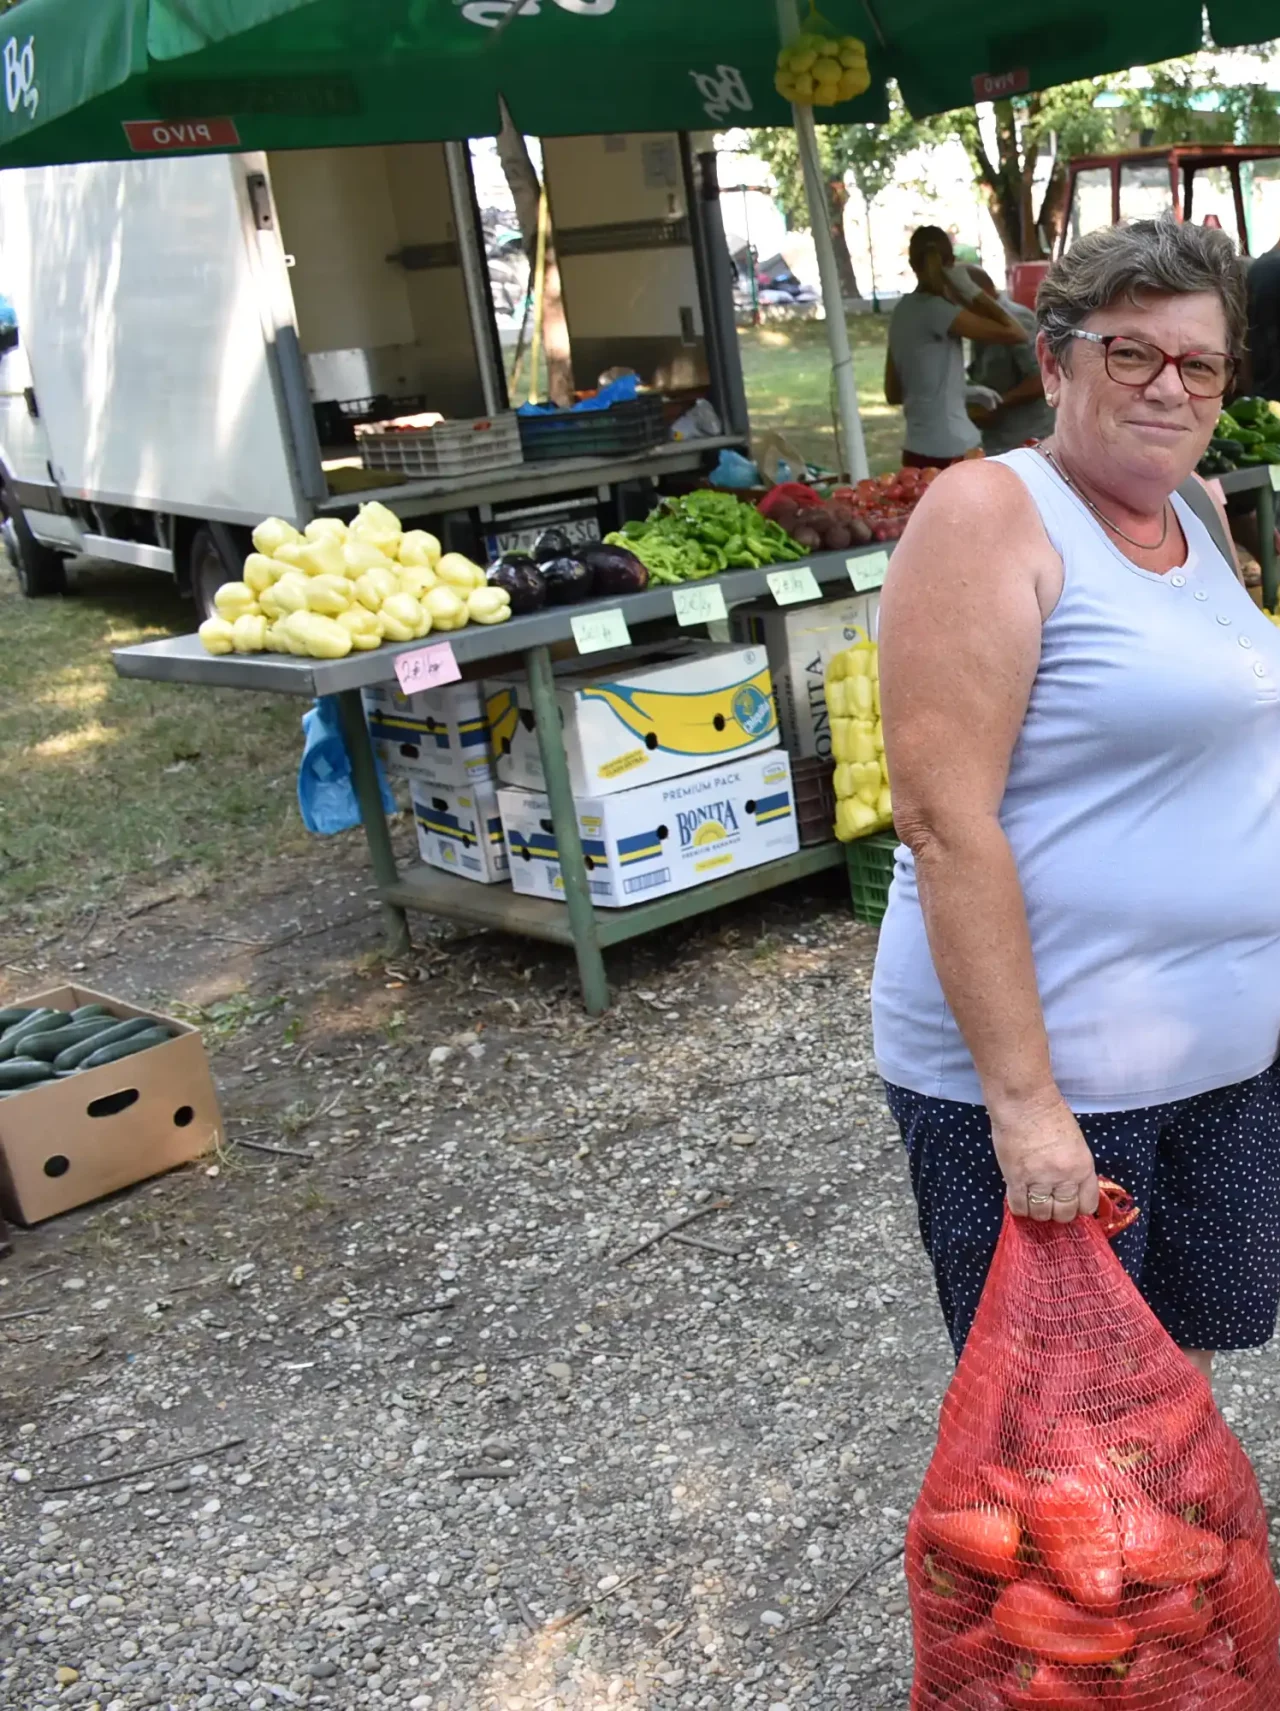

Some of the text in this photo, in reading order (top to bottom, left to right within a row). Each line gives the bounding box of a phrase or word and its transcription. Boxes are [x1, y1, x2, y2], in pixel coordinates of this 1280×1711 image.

[804, 650, 833, 761] ONITA
[662, 773, 741, 800] PREMIUM PACK
[676, 799, 740, 846] BONITA
